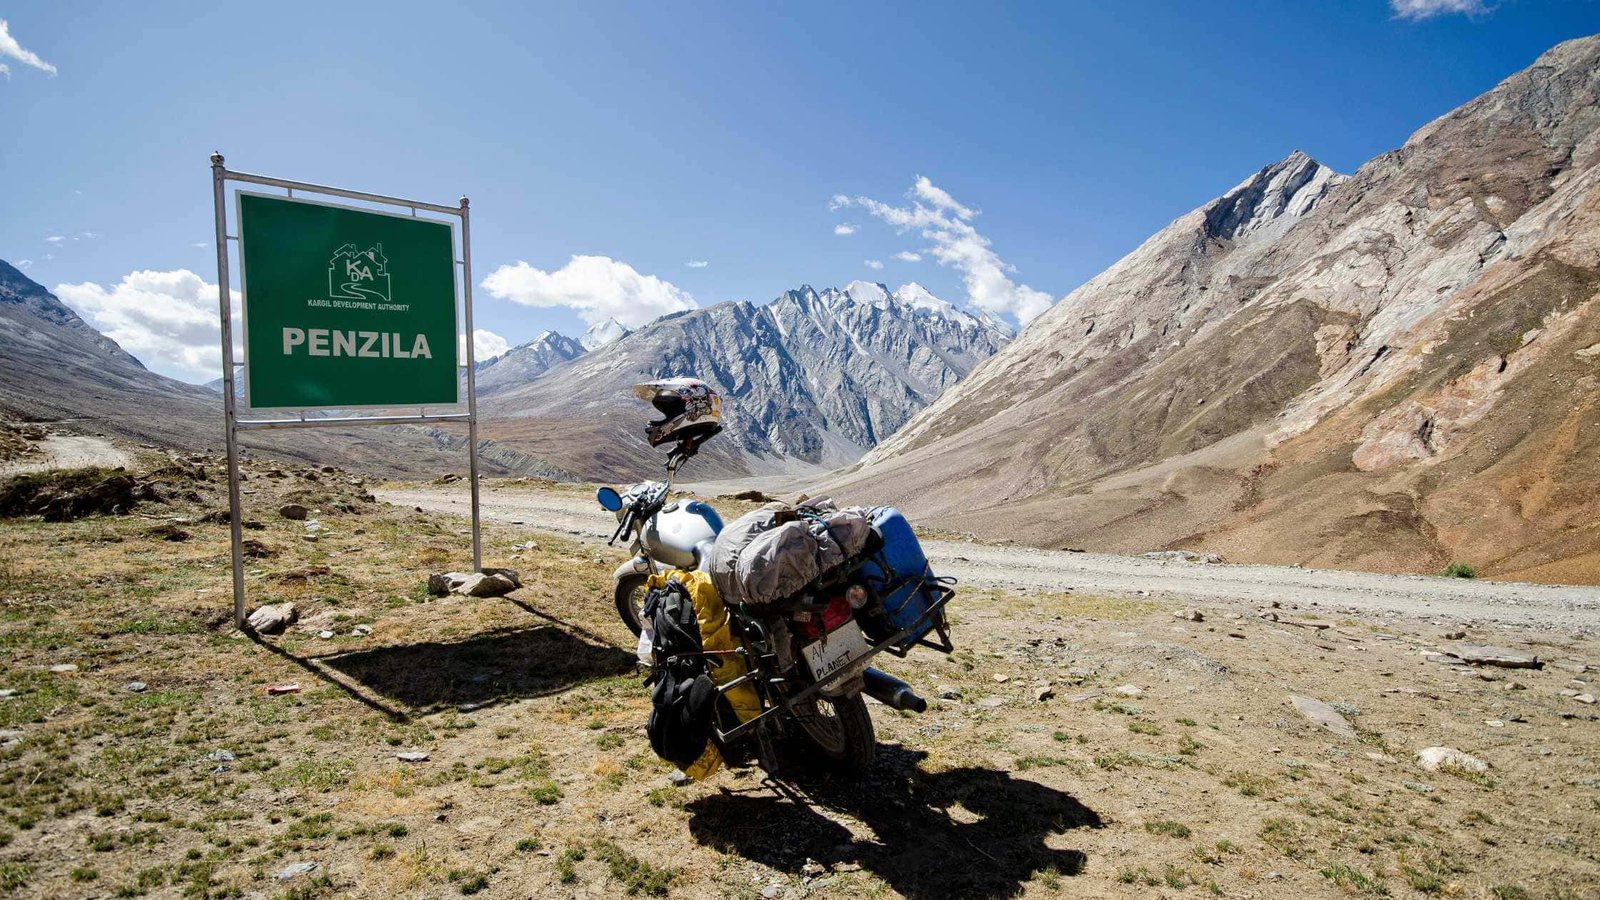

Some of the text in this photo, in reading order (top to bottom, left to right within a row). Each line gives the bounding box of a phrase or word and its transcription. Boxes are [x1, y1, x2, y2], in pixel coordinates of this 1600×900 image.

[308, 299, 410, 312] KARGIL DEVELOPMENT AUTHORITY
[282, 327, 433, 359] PENZILA
[816, 650, 851, 679] PLANET
